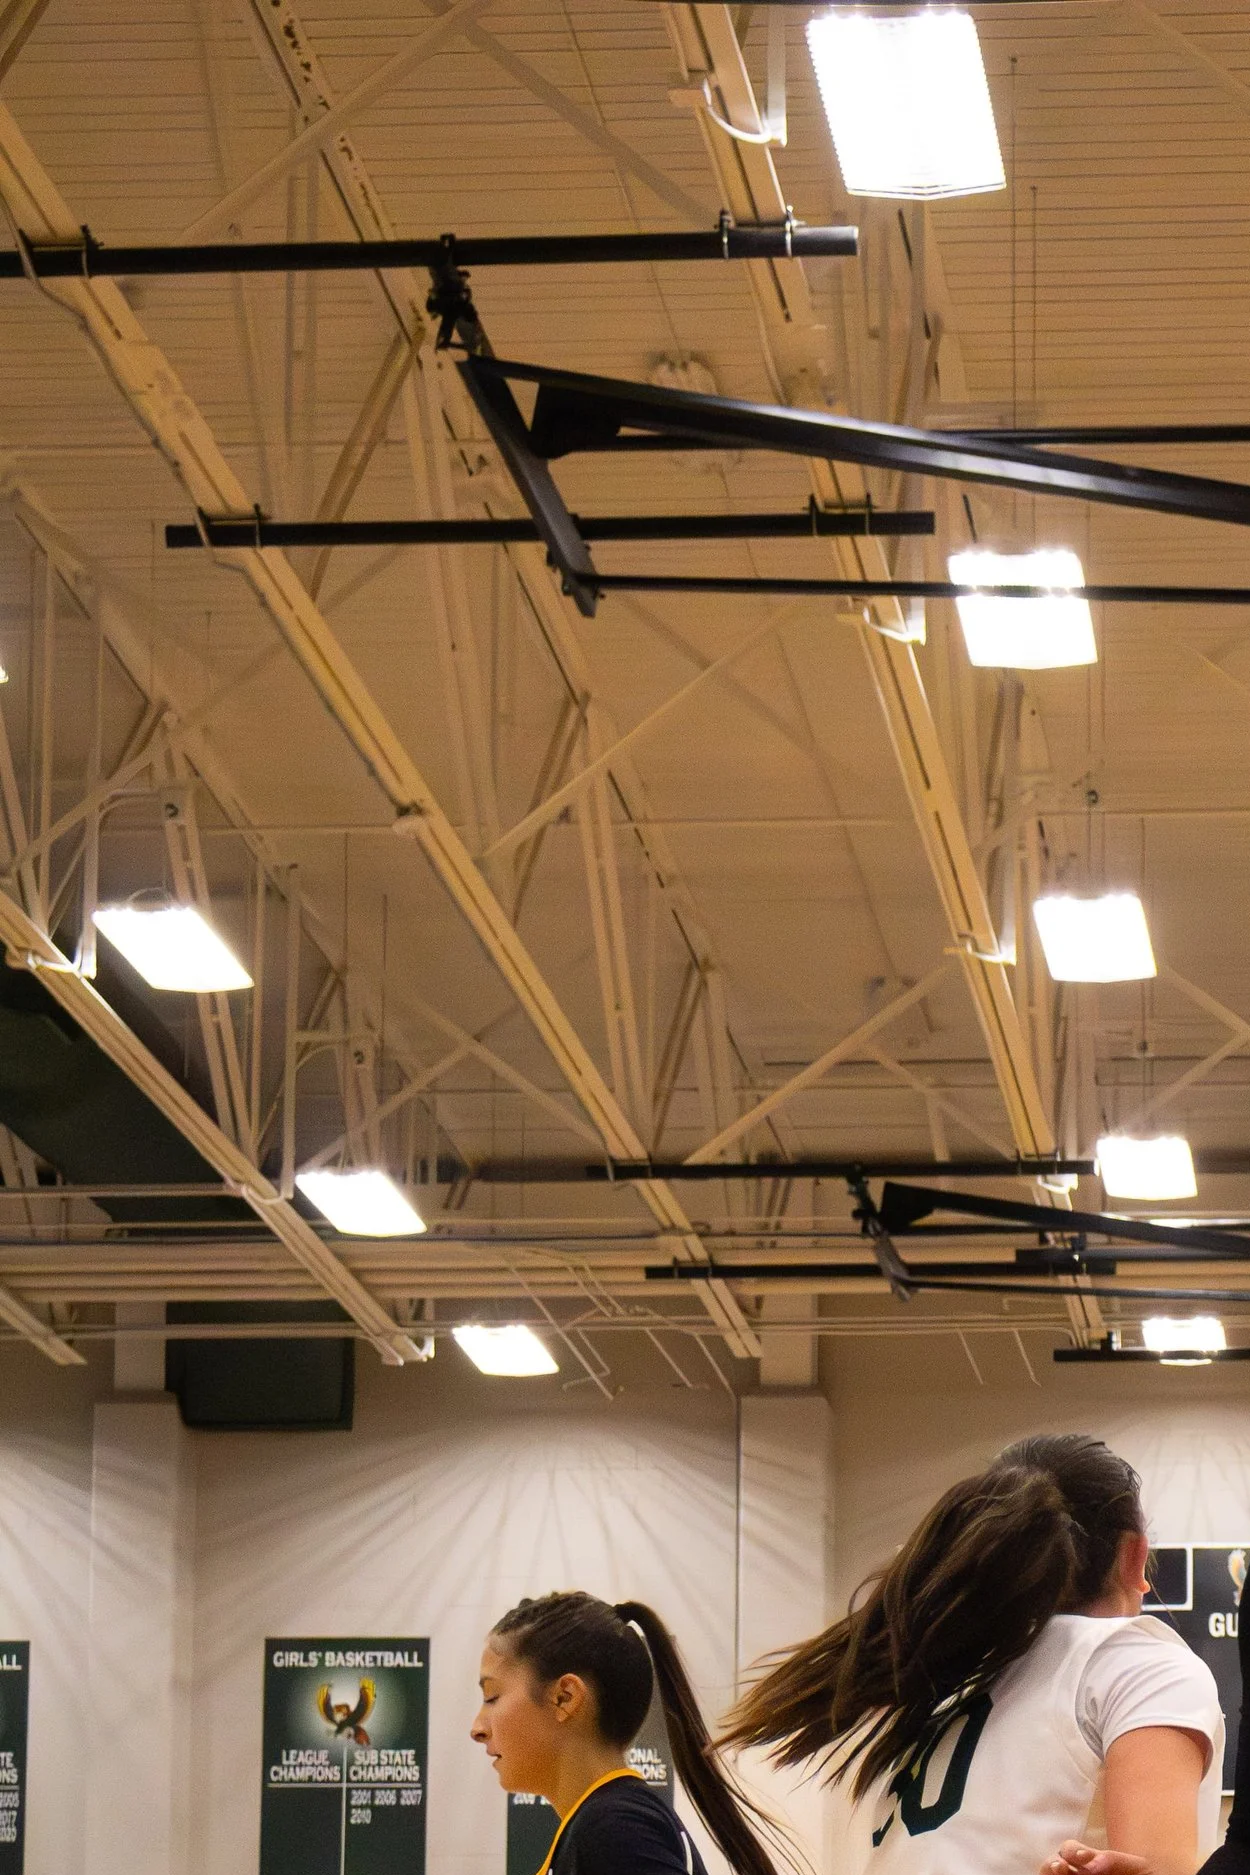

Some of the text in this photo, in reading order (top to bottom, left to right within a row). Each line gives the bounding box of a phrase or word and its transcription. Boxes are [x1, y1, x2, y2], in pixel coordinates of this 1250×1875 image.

[273, 1651, 423, 1668] GIRLS' BASKETBALL
[282, 1750, 329, 1765] LEAGUE
[354, 1750, 416, 1765] SUB STATE
[270, 1766, 340, 1781] CHAMPIONS
[350, 1766, 419, 1781] CHAMPIONS
